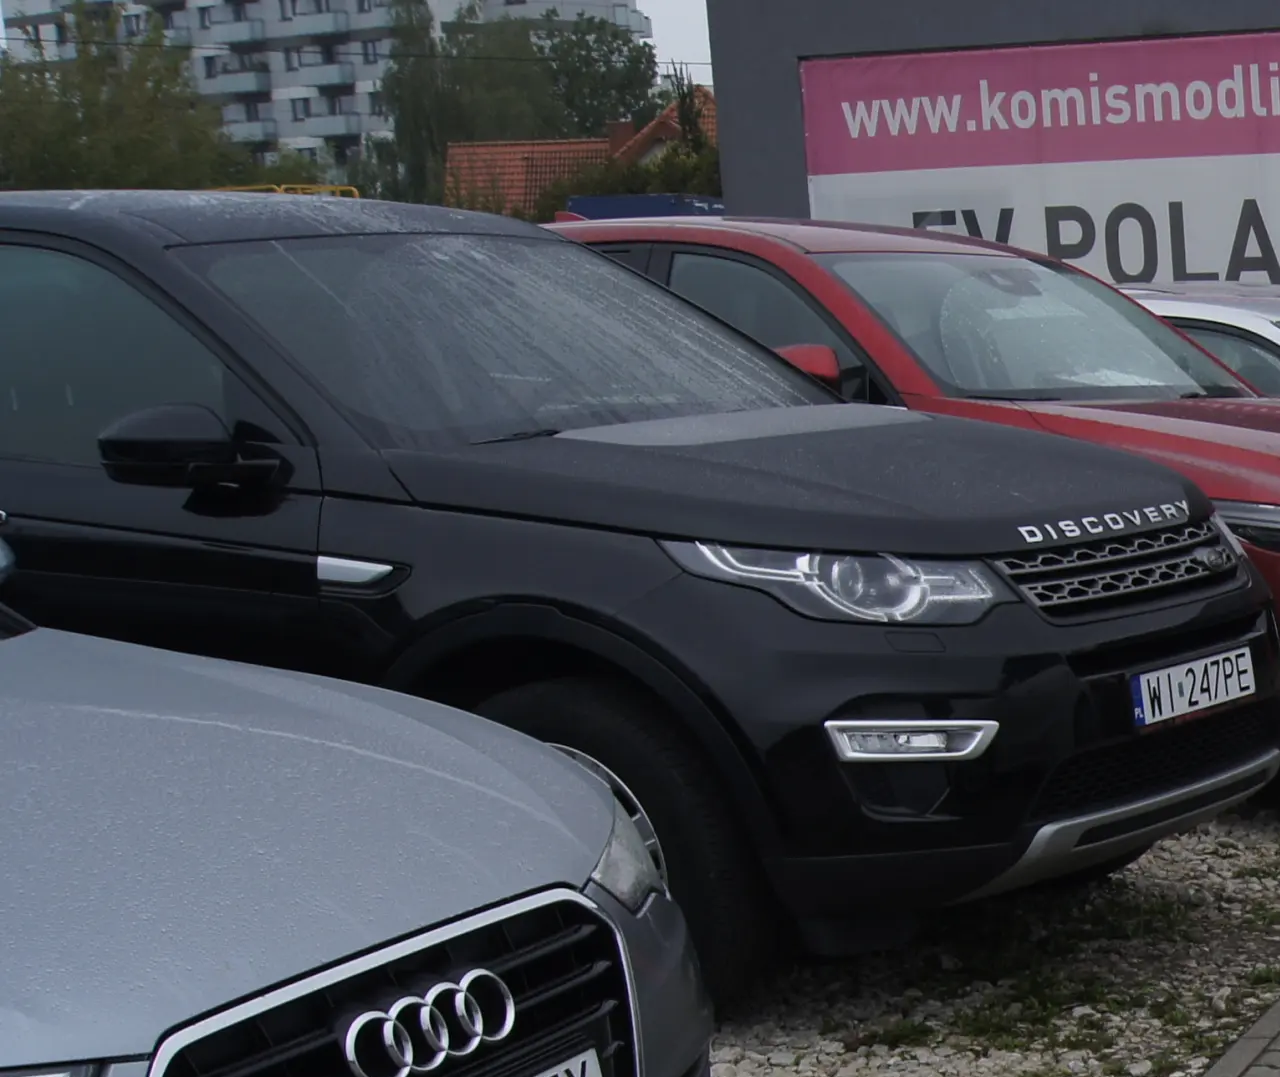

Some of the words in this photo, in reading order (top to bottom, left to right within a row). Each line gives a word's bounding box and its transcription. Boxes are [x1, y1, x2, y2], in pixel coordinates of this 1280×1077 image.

[1017, 500, 1190, 544] DISCOVERY
[1134, 707, 1144, 719] PL
[1146, 672, 1176, 719] WI
[1184, 652, 1251, 707] 247PE
